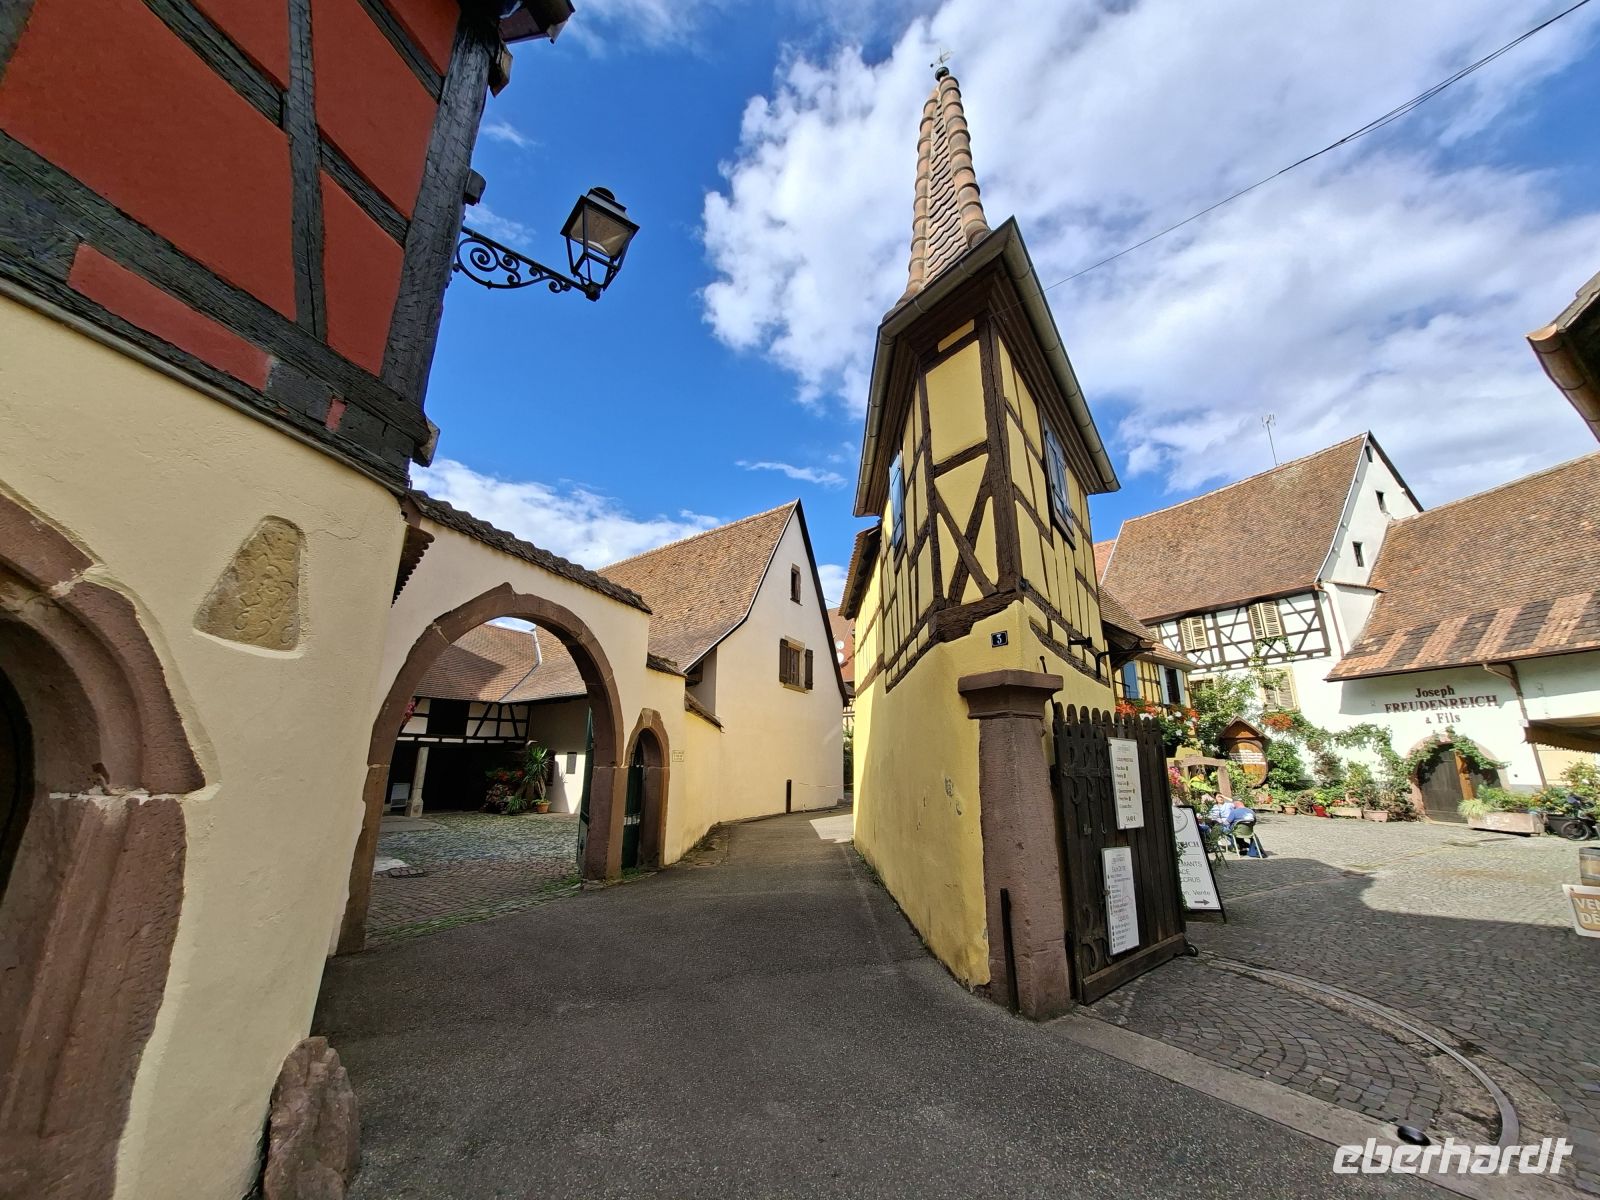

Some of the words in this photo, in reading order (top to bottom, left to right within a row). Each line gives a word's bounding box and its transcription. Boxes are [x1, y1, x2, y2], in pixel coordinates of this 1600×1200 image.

[1415, 685, 1455, 698] Joseph
[1384, 695, 1500, 713] FREUDENREICH
[1436, 712, 1461, 724] Fils
